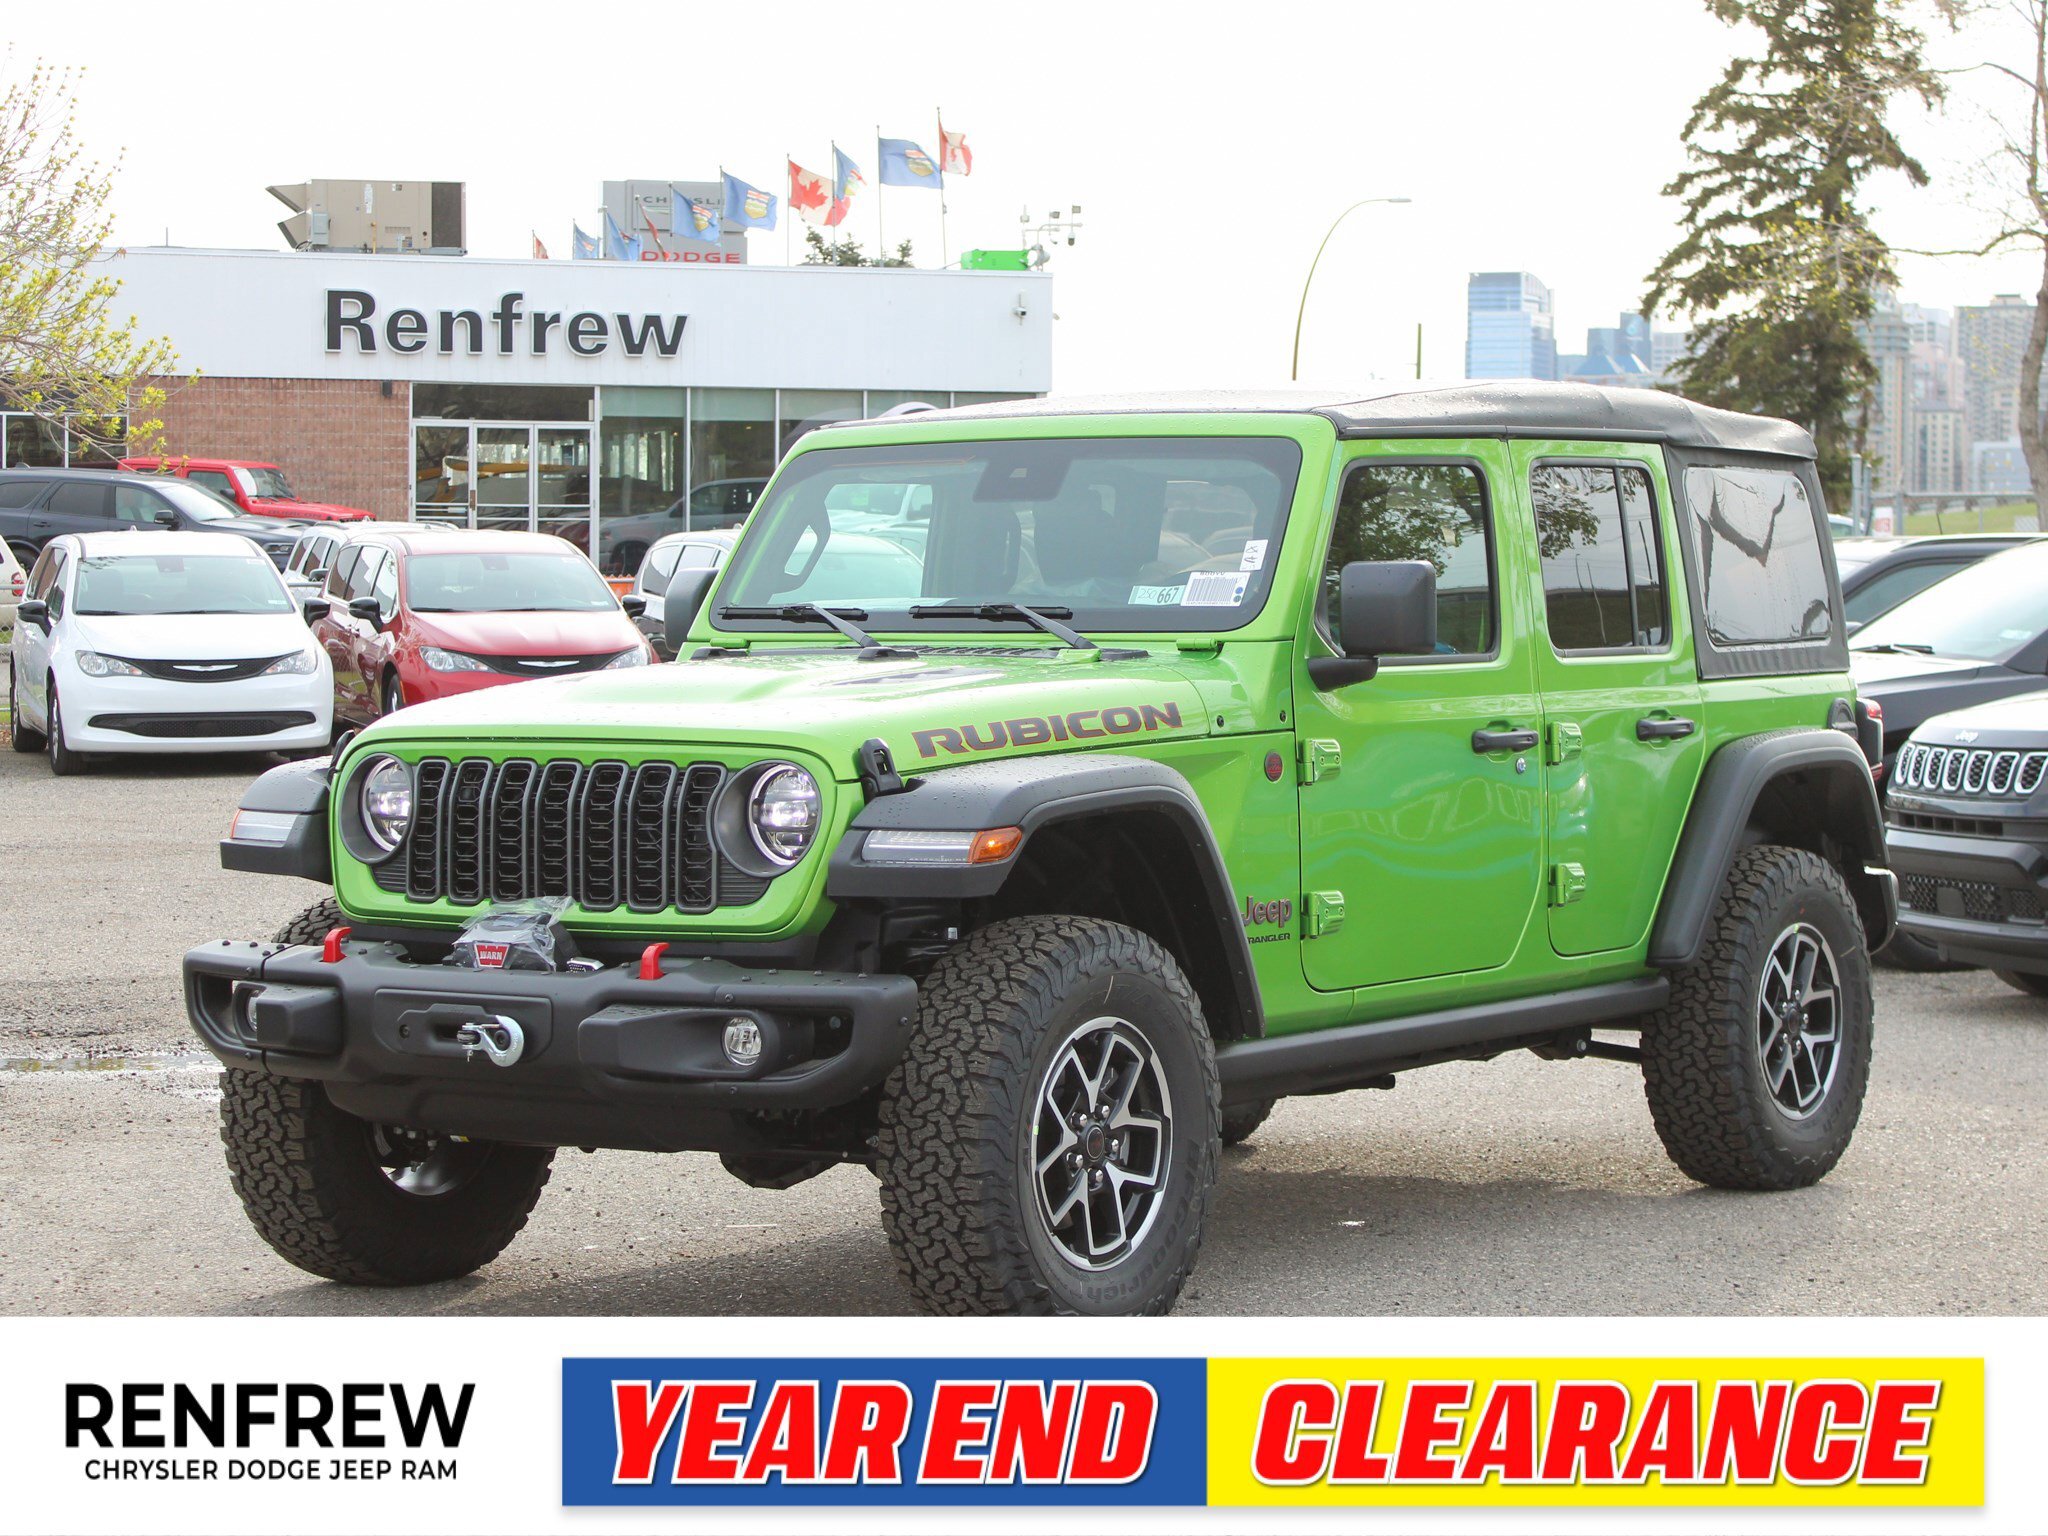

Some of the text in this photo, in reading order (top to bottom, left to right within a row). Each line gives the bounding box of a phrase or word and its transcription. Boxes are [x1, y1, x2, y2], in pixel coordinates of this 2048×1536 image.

[326, 289, 688, 356] Renfrew
[1157, 587, 1179, 603] 667
[912, 702, 1183, 758] RUBICON
[1241, 896, 1292, 928] Jeep
[1247, 933, 1290, 944] RANGLER
[479, 950, 503, 960] WARN
